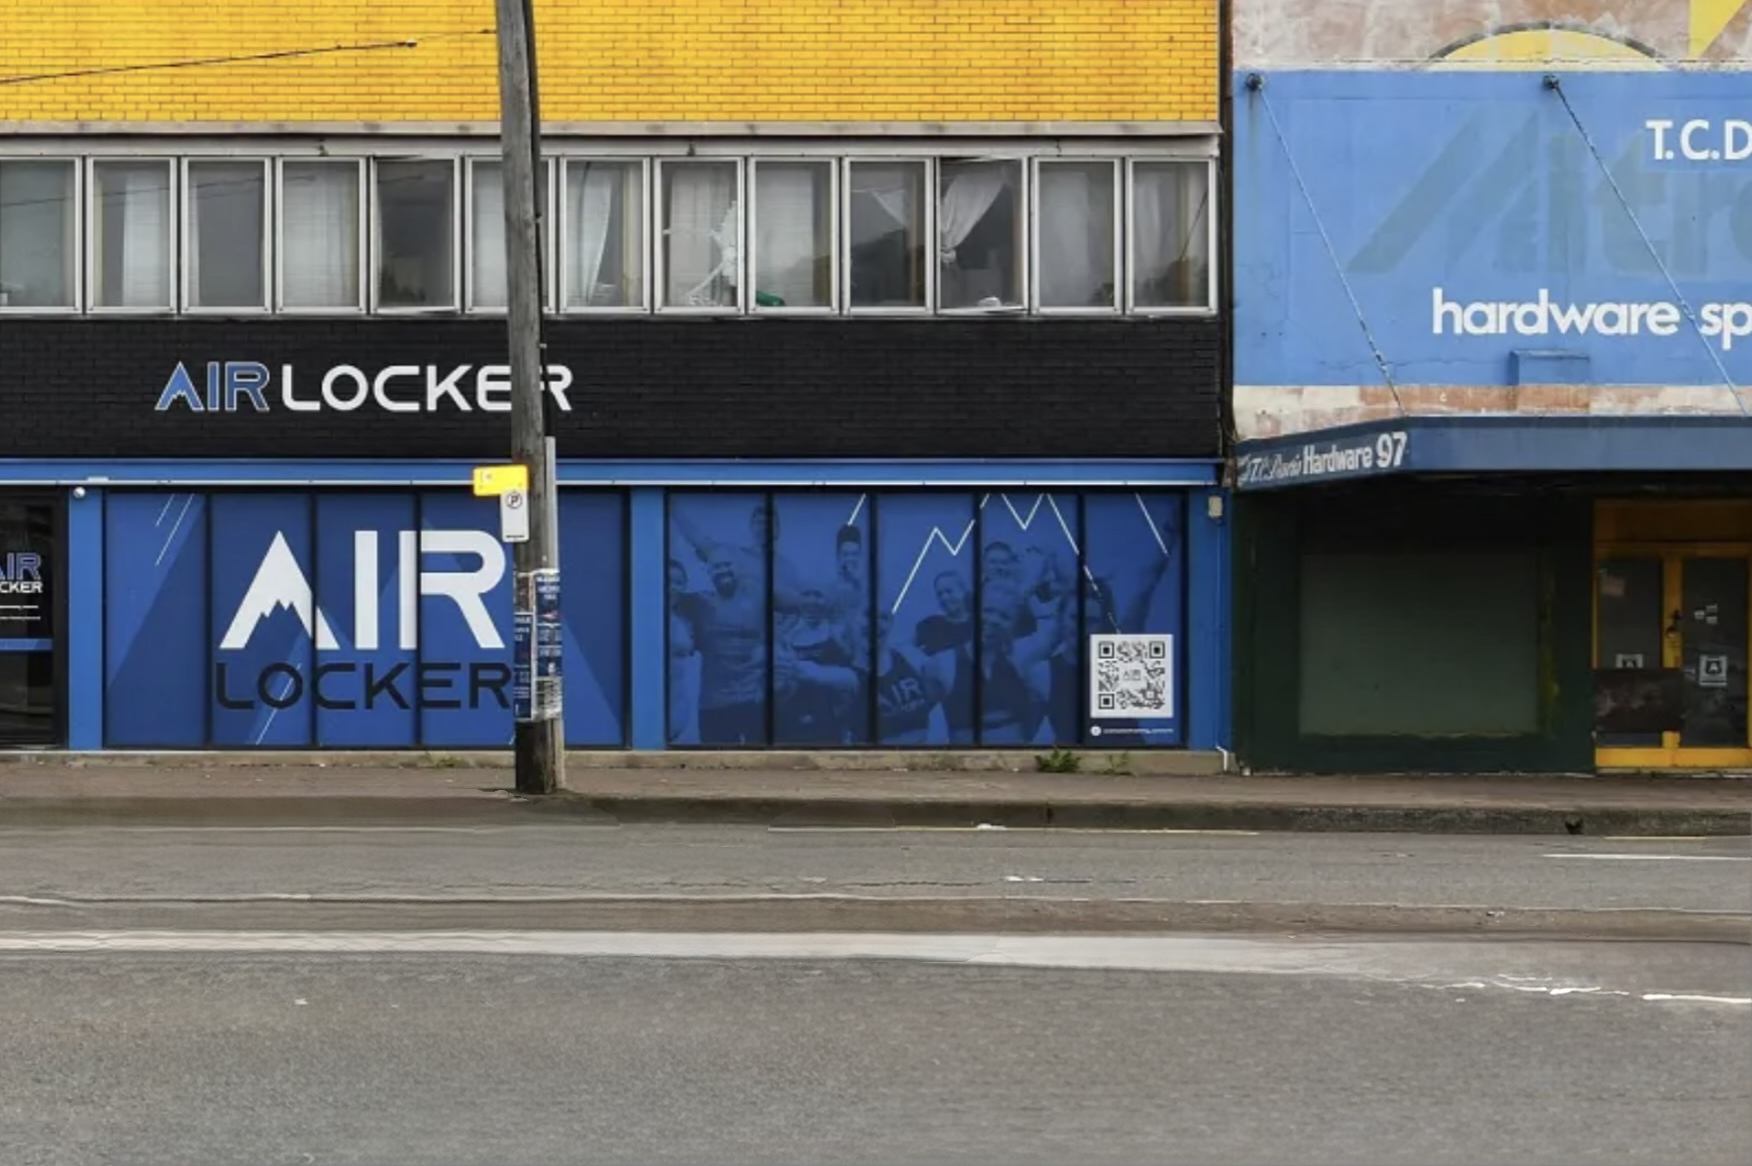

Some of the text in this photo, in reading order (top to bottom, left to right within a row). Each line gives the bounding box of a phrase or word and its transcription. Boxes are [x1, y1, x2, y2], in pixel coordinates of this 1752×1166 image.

[1432, 288, 1680, 336] hardware
[154, 361, 573, 411] AIR LOCKER
[1303, 445, 1372, 475] Hardware
[1376, 432, 1408, 468] 97
[218, 530, 507, 650] AIR
[215, 663, 513, 710] LOCKER
